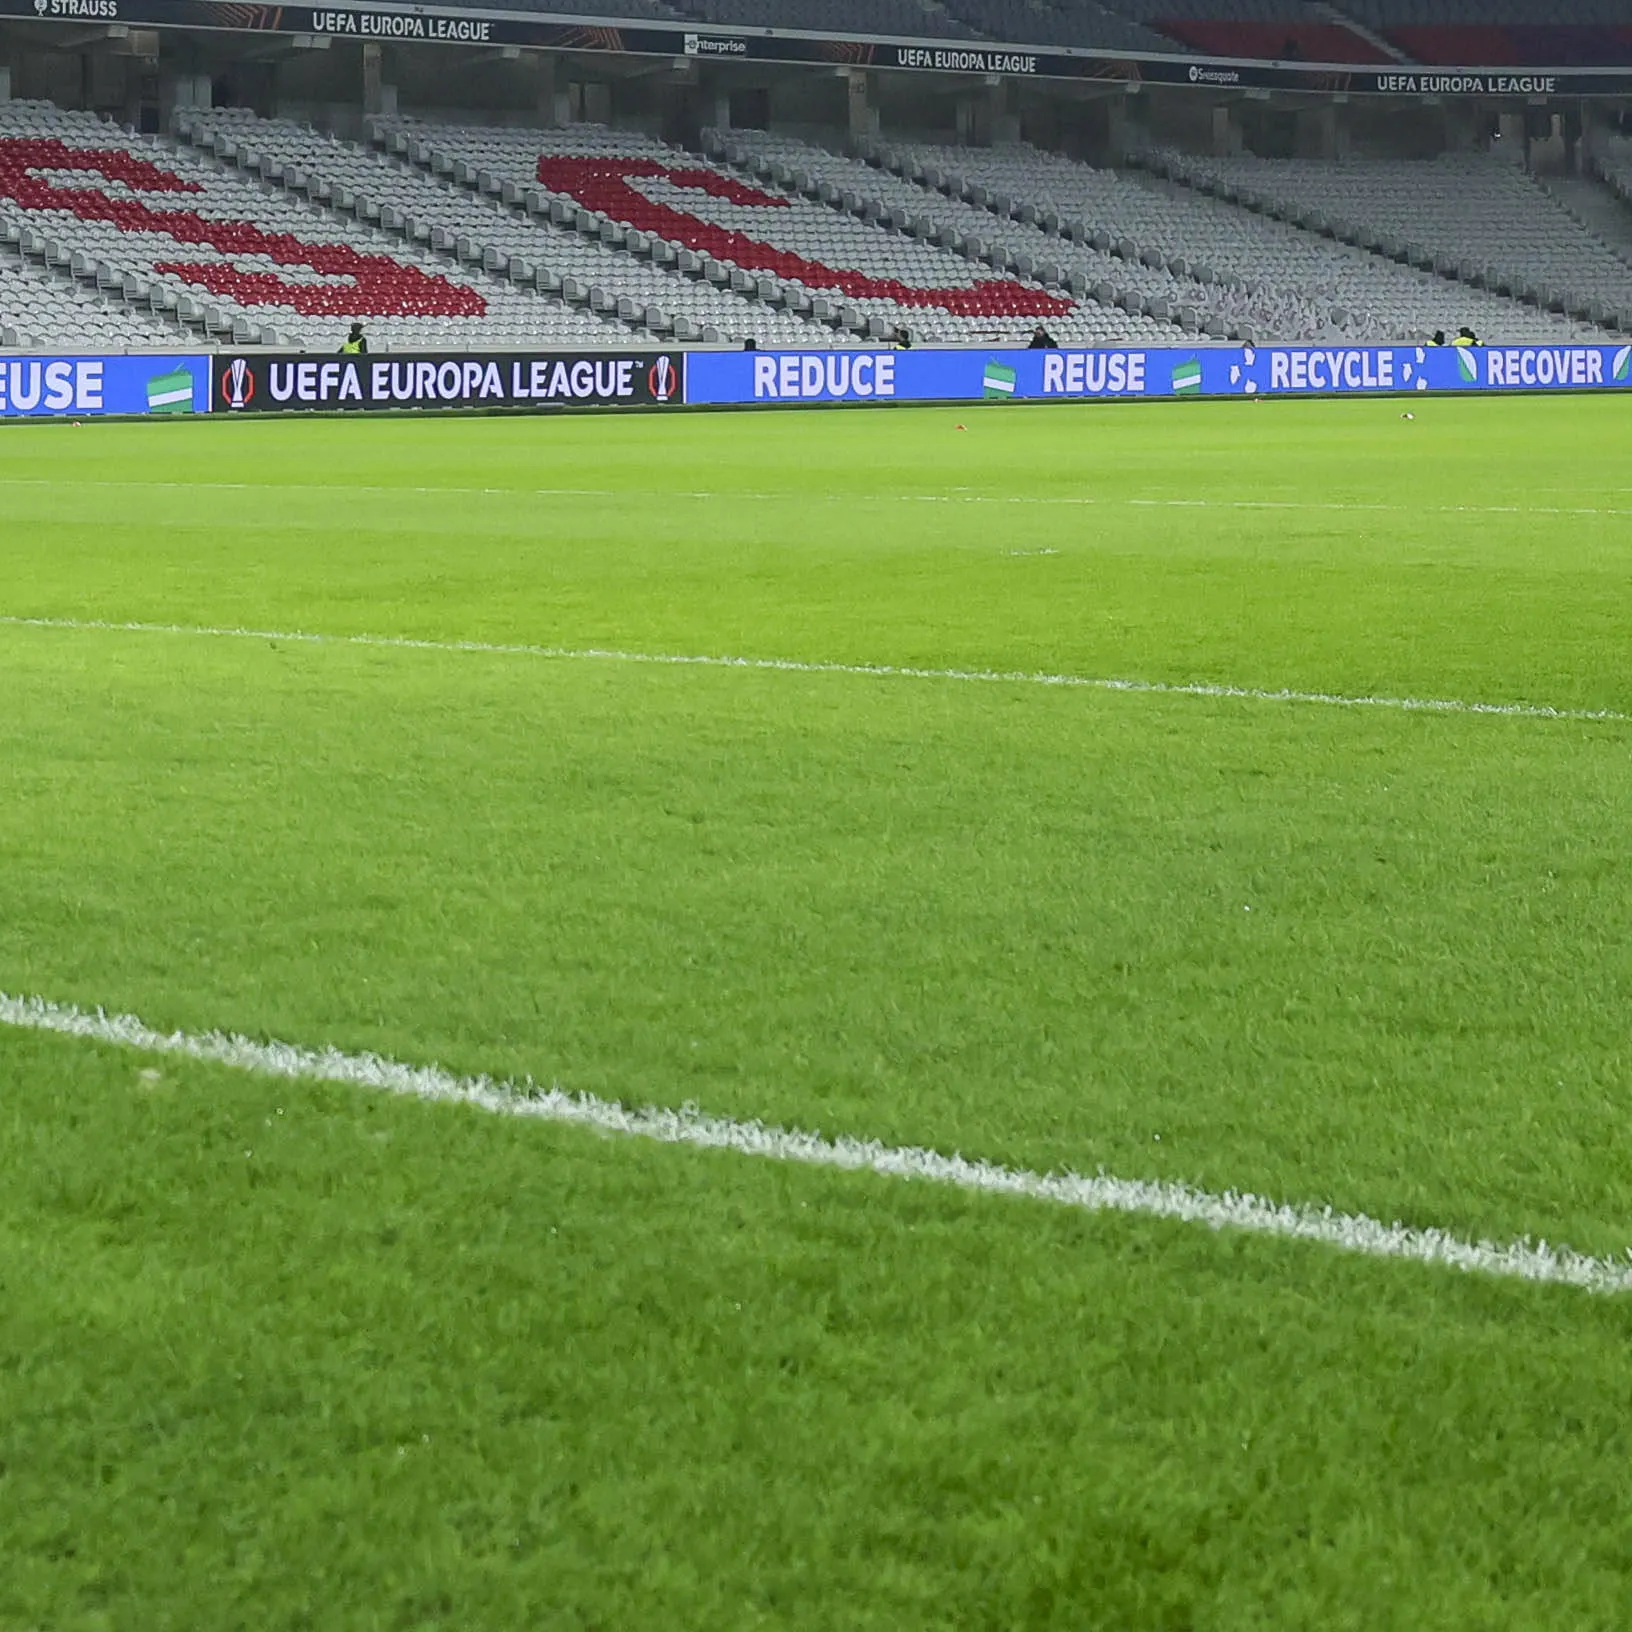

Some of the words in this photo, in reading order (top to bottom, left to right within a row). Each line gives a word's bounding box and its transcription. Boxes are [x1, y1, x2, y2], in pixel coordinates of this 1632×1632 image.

[312, 11, 357, 33] UEFA
[360, 14, 425, 37] EUROPA
[687, 39, 746, 54] enterprise
[898, 48, 933, 66] UEFA
[935, 50, 985, 71] EUROPA
[987, 53, 1036, 73] LEAGUE
[1377, 74, 1417, 92] UEFA
[1420, 76, 1484, 93] EUROPA
[1487, 76, 1556, 93] LEAGUE
[270, 361, 363, 401] UEFA
[371, 361, 509, 400] EUROPA
[753, 355, 895, 397] REDUCE
[1043, 353, 1146, 393] REUSE
[1271, 351, 1393, 388] RECYCLE
[1487, 349, 1603, 385] RECOVER
